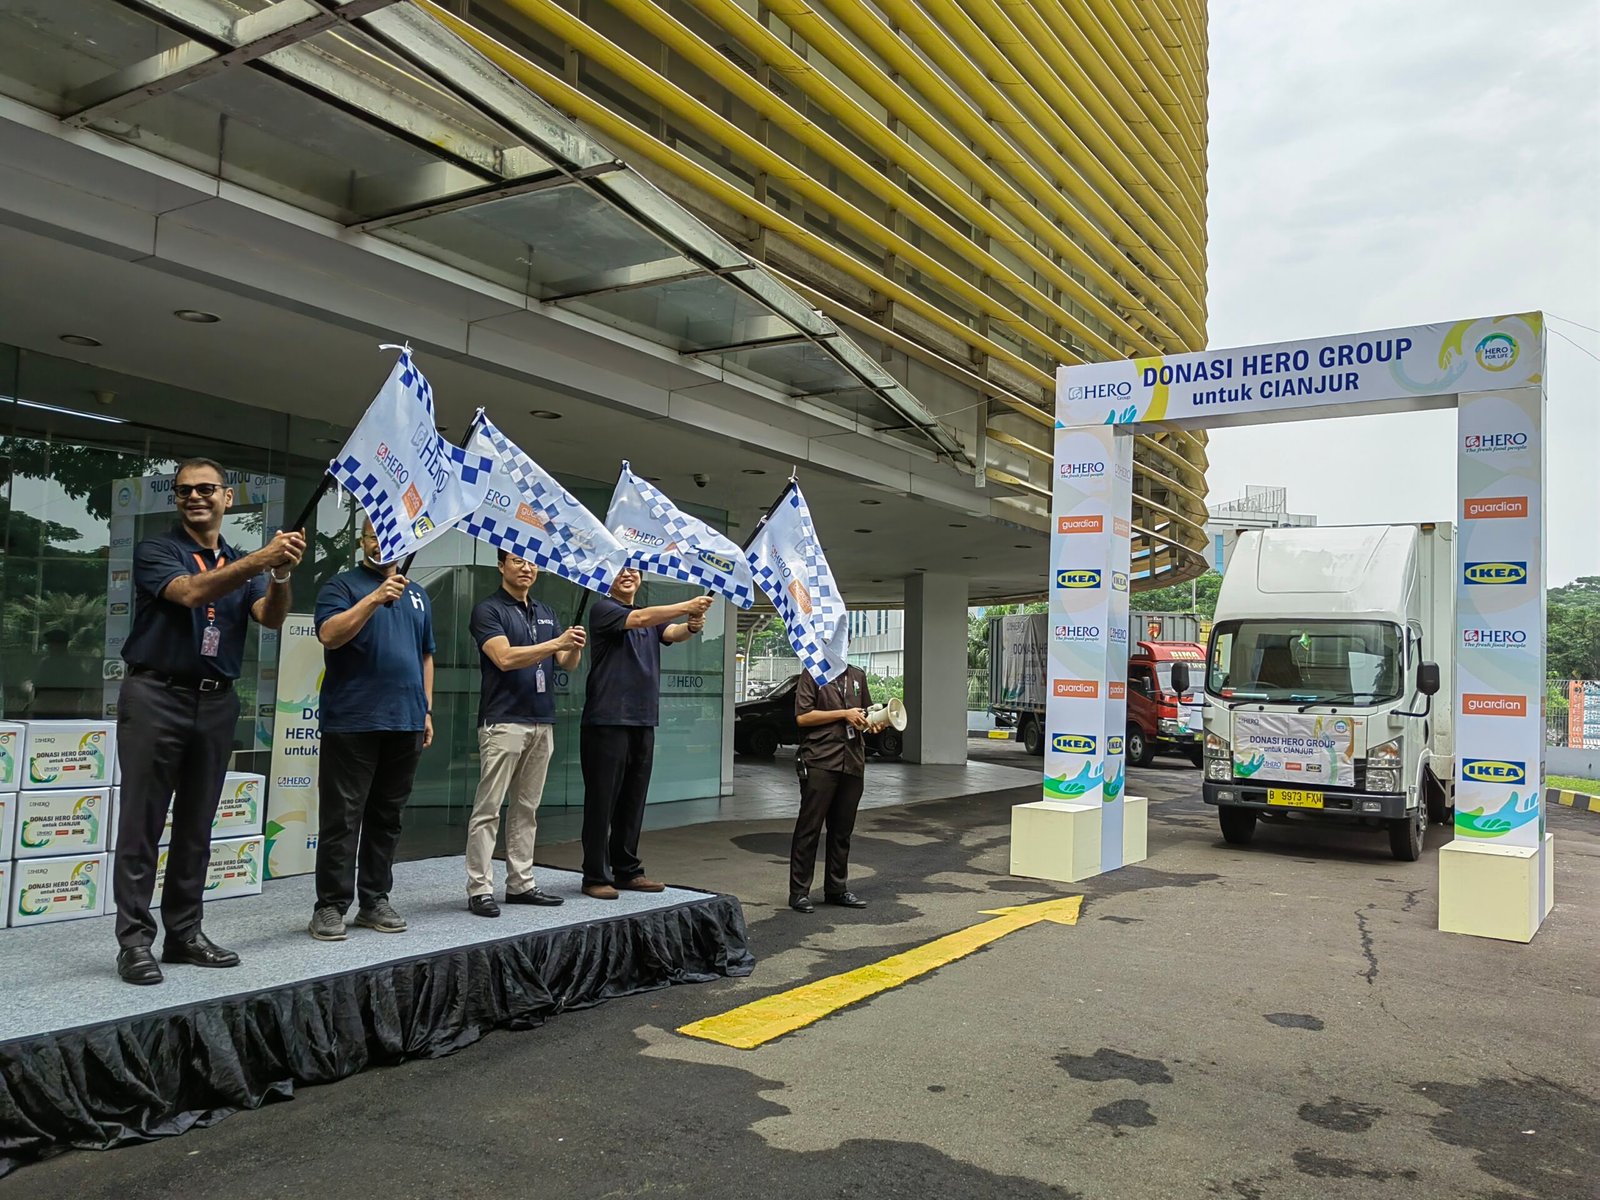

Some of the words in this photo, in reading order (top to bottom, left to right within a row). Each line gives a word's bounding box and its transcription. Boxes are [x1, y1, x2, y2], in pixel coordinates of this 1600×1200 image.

[1485, 346, 1508, 355] HERO
[1143, 358, 1233, 387] DONASI
[1242, 349, 1309, 377] HERO
[1318, 337, 1412, 368] GROUP
[1084, 382, 1132, 399] HERO
[1192, 383, 1253, 406] untuk
[1259, 372, 1359, 399] CIANJUR
[1482, 432, 1527, 447] HERO
[384, 450, 409, 484] HERO
[1072, 462, 1104, 473] HERO
[485, 489, 511, 507] ERO
[1469, 501, 1522, 514] guardian
[416, 518, 429, 534] IKE
[1062, 519, 1099, 530] guardian
[635, 530, 664, 546] HERO
[702, 551, 730, 569] IKEA
[1061, 575, 1097, 583] IKEA
[1470, 568, 1522, 578] IKEA
[301, 626, 316, 636] HE
[1067, 626, 1099, 637] HERO
[1480, 630, 1526, 643] HERO
[1170, 651, 1199, 659] BIMA
[553, 672, 568, 687] RO
[676, 675, 703, 688] HERO
[1057, 683, 1094, 693] guardian
[1468, 699, 1521, 710] guardian
[1056, 739, 1092, 749] IKEA
[1249, 735, 1280, 745] DONASI
[1281, 737, 1304, 747] HERO
[1306, 738, 1335, 748] GROUP
[285, 745, 318, 756] untuk
[1283, 747, 1313, 755] CIANJUR
[1468, 764, 1520, 778] IKEA
[287, 777, 310, 785] HERO
[1270, 790, 1275, 800] B
[1281, 790, 1302, 801] 9973
